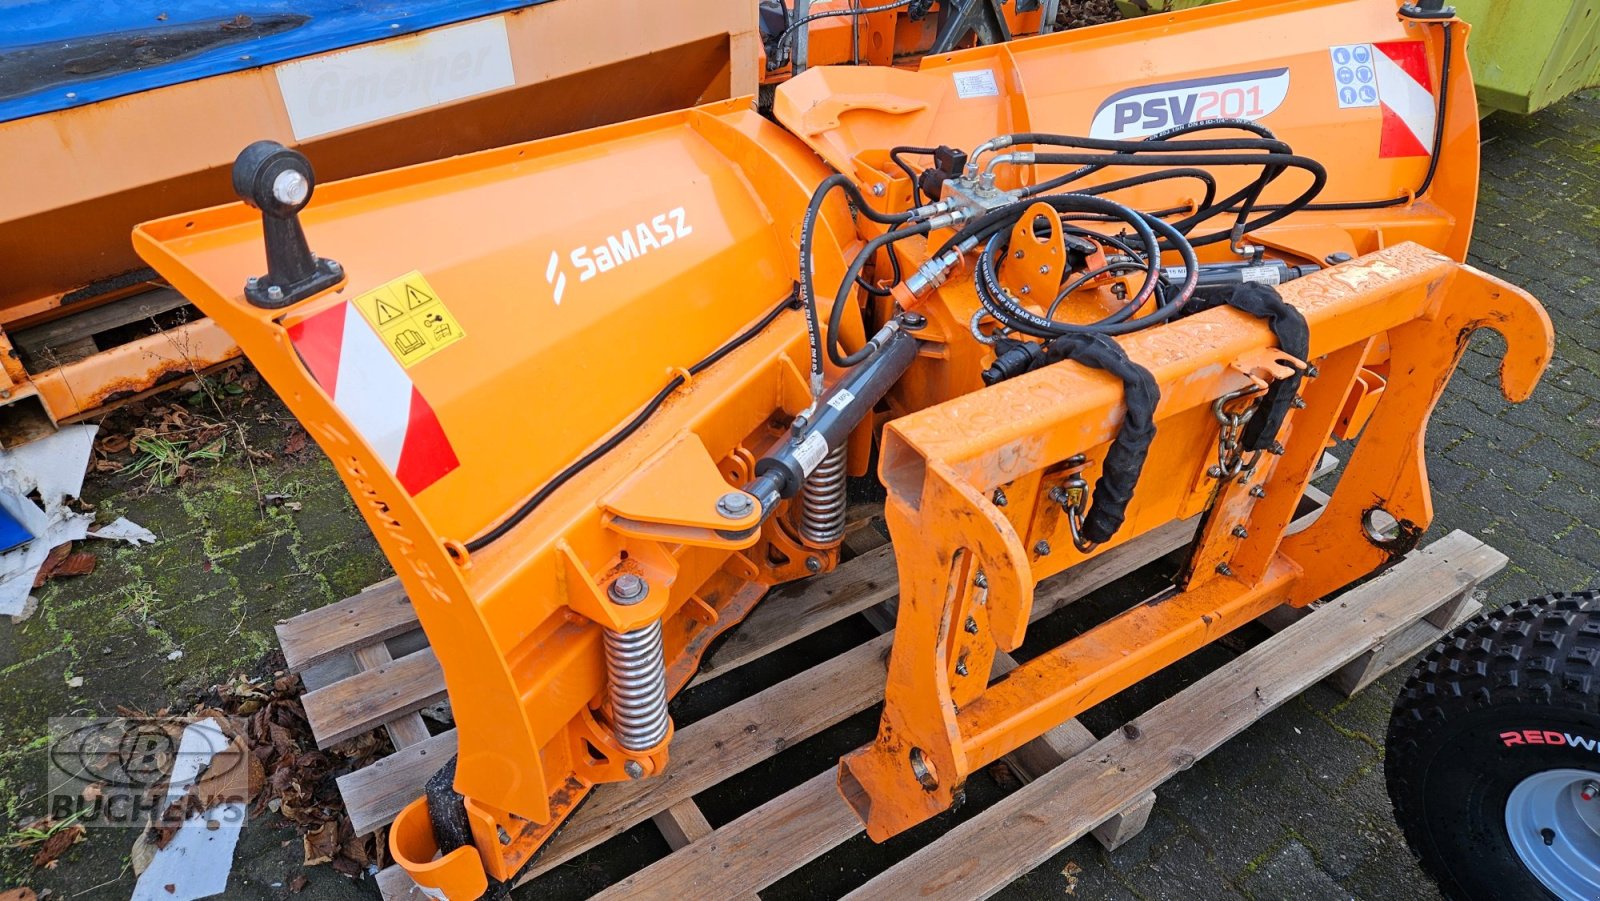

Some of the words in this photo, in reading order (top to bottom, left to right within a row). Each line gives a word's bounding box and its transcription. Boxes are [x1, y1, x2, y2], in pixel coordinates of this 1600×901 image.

[1113, 86, 1264, 134] PSV201
[570, 206, 693, 283] SaMASZ
[1014, 306, 1030, 320] BAR
